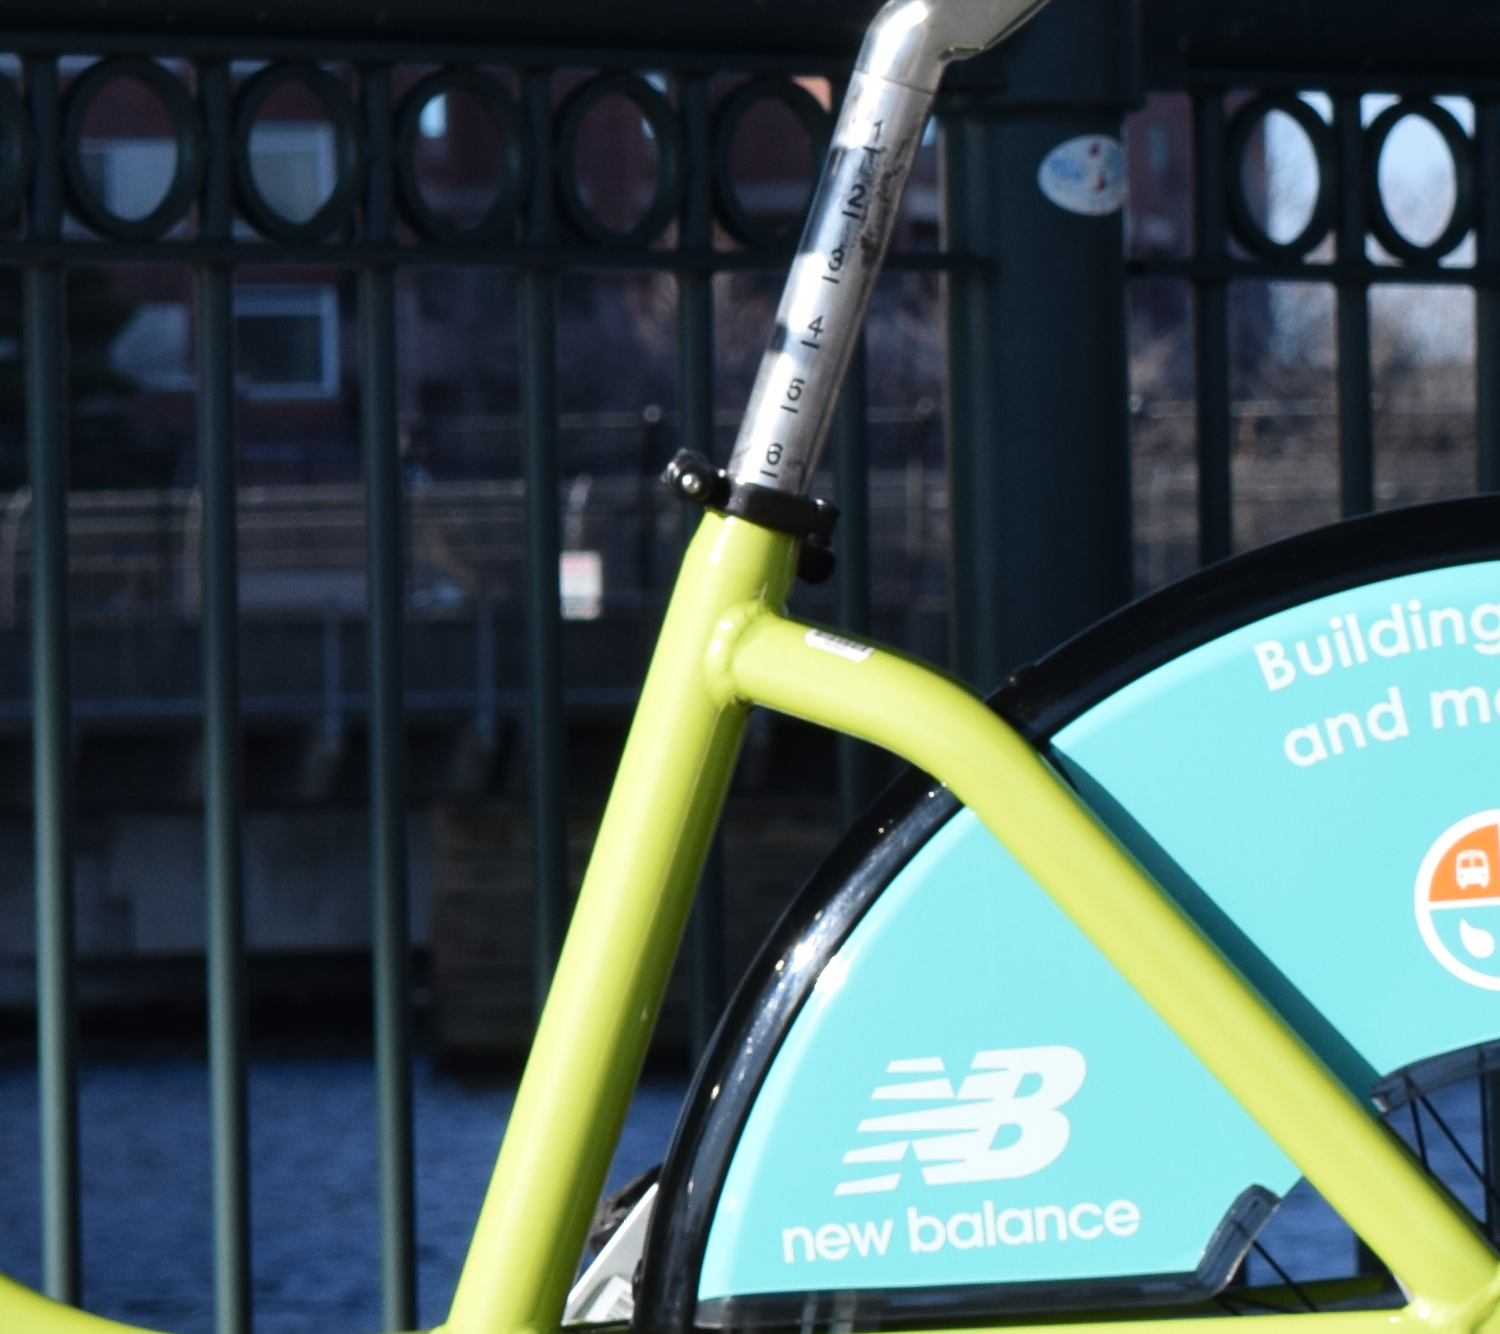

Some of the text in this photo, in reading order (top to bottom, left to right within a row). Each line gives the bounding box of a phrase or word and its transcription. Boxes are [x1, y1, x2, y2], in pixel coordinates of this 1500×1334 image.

[872, 119, 884, 143] 1
[846, 183, 867, 209] 2
[827, 247, 845, 272] 3
[807, 314, 825, 339] 4
[786, 377, 806, 402] 5
[765, 441, 785, 466] 6
[1283, 685, 1411, 768] and
[833, 1044, 1088, 1197] NB
[781, 1198, 1142, 1264] new balance
